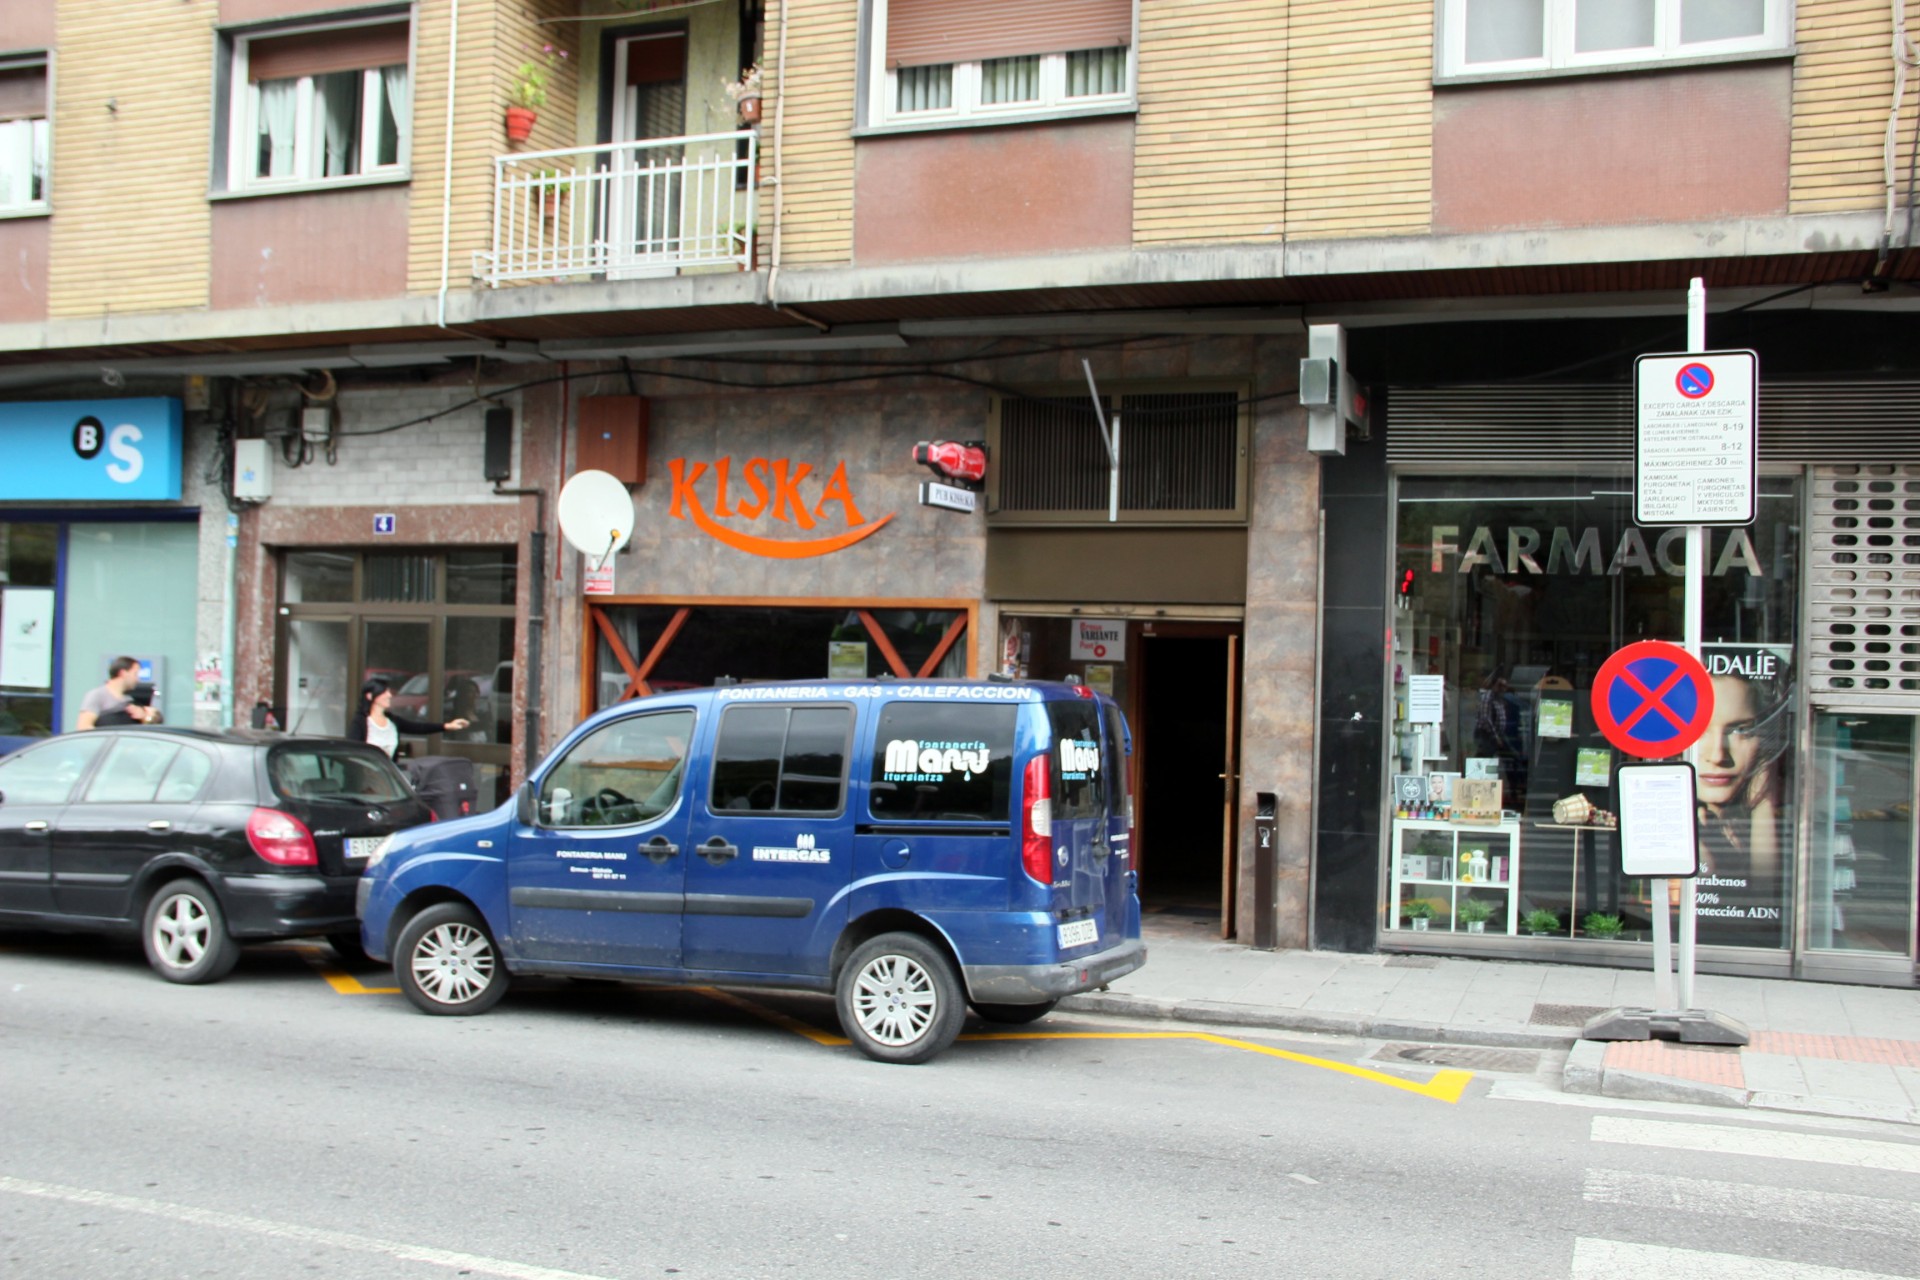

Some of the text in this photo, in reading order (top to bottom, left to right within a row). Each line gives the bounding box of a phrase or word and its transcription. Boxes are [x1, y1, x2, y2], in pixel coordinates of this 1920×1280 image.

[1643, 402, 1675, 410] EXCEPTO
[1676, 401, 1700, 409] CARGA
[1707, 400, 1746, 408] DESCARGA
[1656, 409, 1698, 417] ZAMALANAK
[1722, 423, 1744, 432] 8-19
[1721, 442, 1742, 450] 8-12
[1714, 457, 1727, 465] 30
[667, 455, 866, 530] KISKA
[1431, 526, 1763, 577] FARMACIA
[1080, 630, 1119, 641] VARIANTE
[1707, 649, 1776, 676] UDALÍE
[718, 686, 828, 700] FONTANERIA
[843, 685, 882, 698] GAS
[897, 686, 1031, 700] CALEFACCION
[556, 850, 627, 860] FONTANERIA MANU
[752, 848, 831, 862] INTERGAS
[1695, 875, 1747, 887] arabenos
[1695, 906, 1779, 919] rotección ADN
